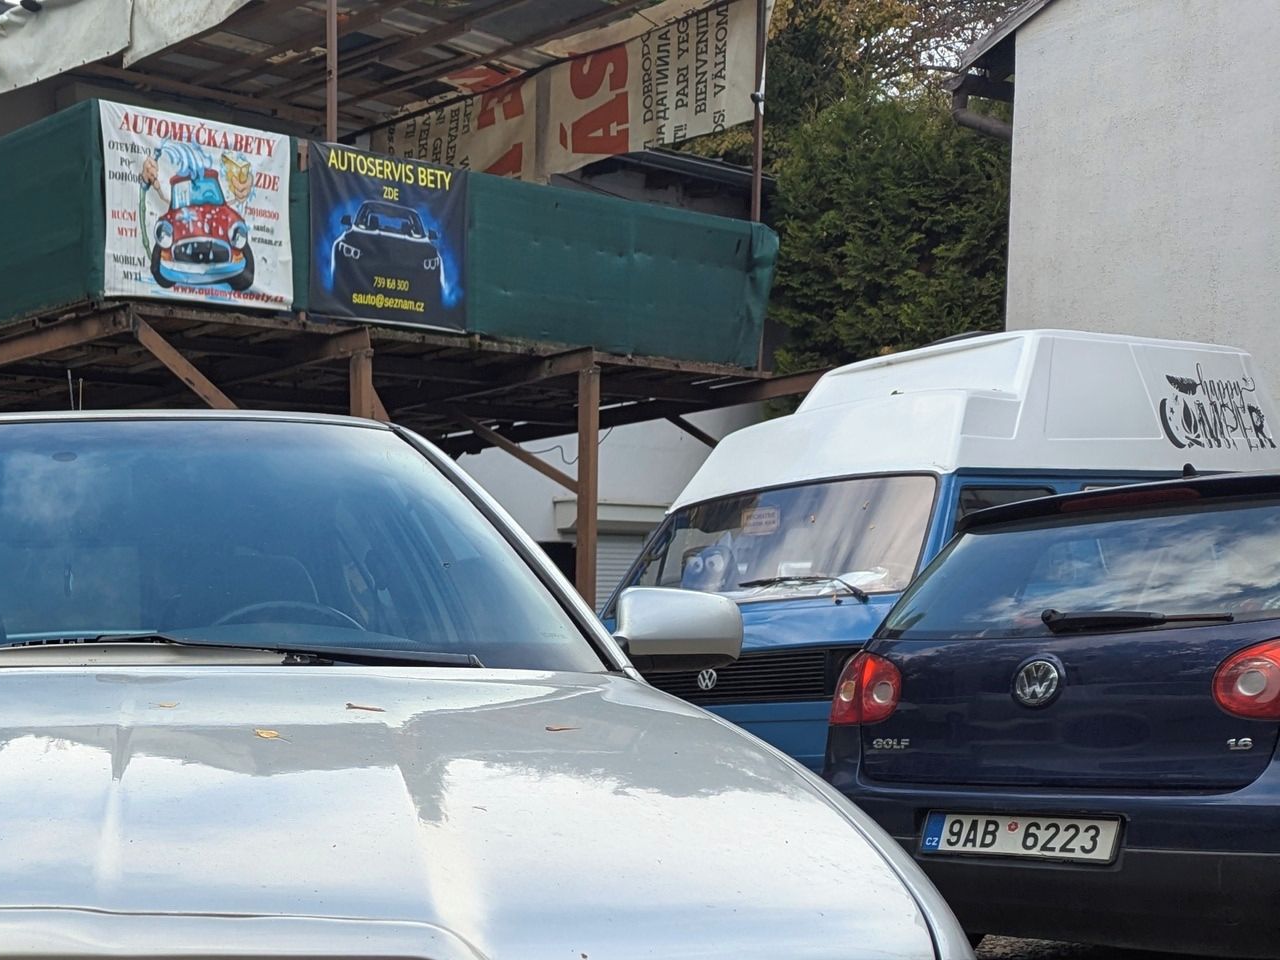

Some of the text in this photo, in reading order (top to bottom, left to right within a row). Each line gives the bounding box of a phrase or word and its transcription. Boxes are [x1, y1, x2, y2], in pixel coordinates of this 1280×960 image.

[119, 111, 276, 157] AUTOMYČKA BETY
[328, 148, 452, 191] AUTOSERVIS BETY
[255, 172, 280, 192] ZDE
[383, 186, 400, 201] ZDE
[111, 209, 137, 222] RUČNÍ
[117, 226, 138, 238] MYTÍ
[113, 253, 146, 267] MOBILNÍ
[352, 292, 425, 312] sauto@seznam.cz
[872, 738, 910, 749] GOLF
[925, 836, 939, 847] CZ
[946, 818, 1101, 855] 9AB 6223
